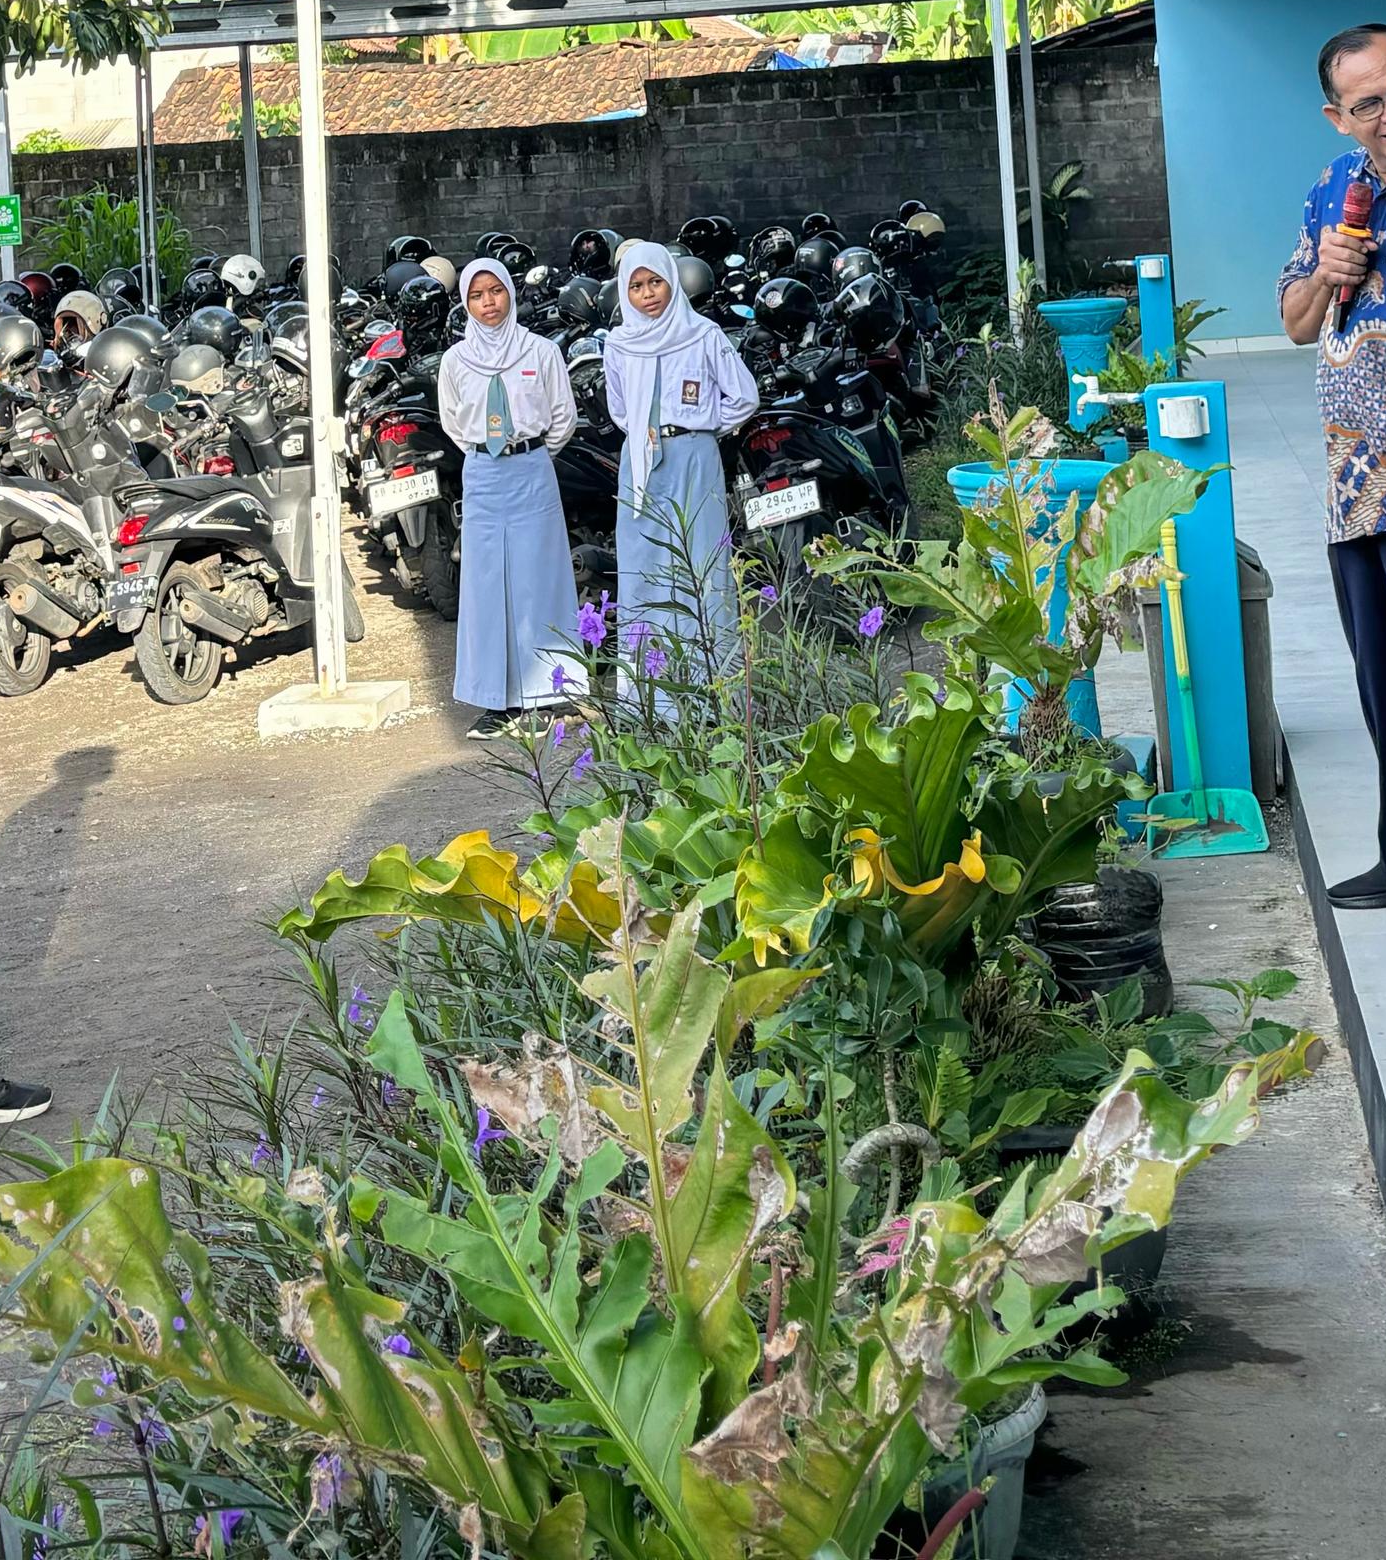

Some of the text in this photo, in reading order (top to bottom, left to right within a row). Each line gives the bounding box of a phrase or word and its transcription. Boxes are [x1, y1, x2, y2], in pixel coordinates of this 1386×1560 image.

[766, 491, 793, 509] 2946
[799, 485, 813, 498] WP
[116, 580, 144, 596] 5946
